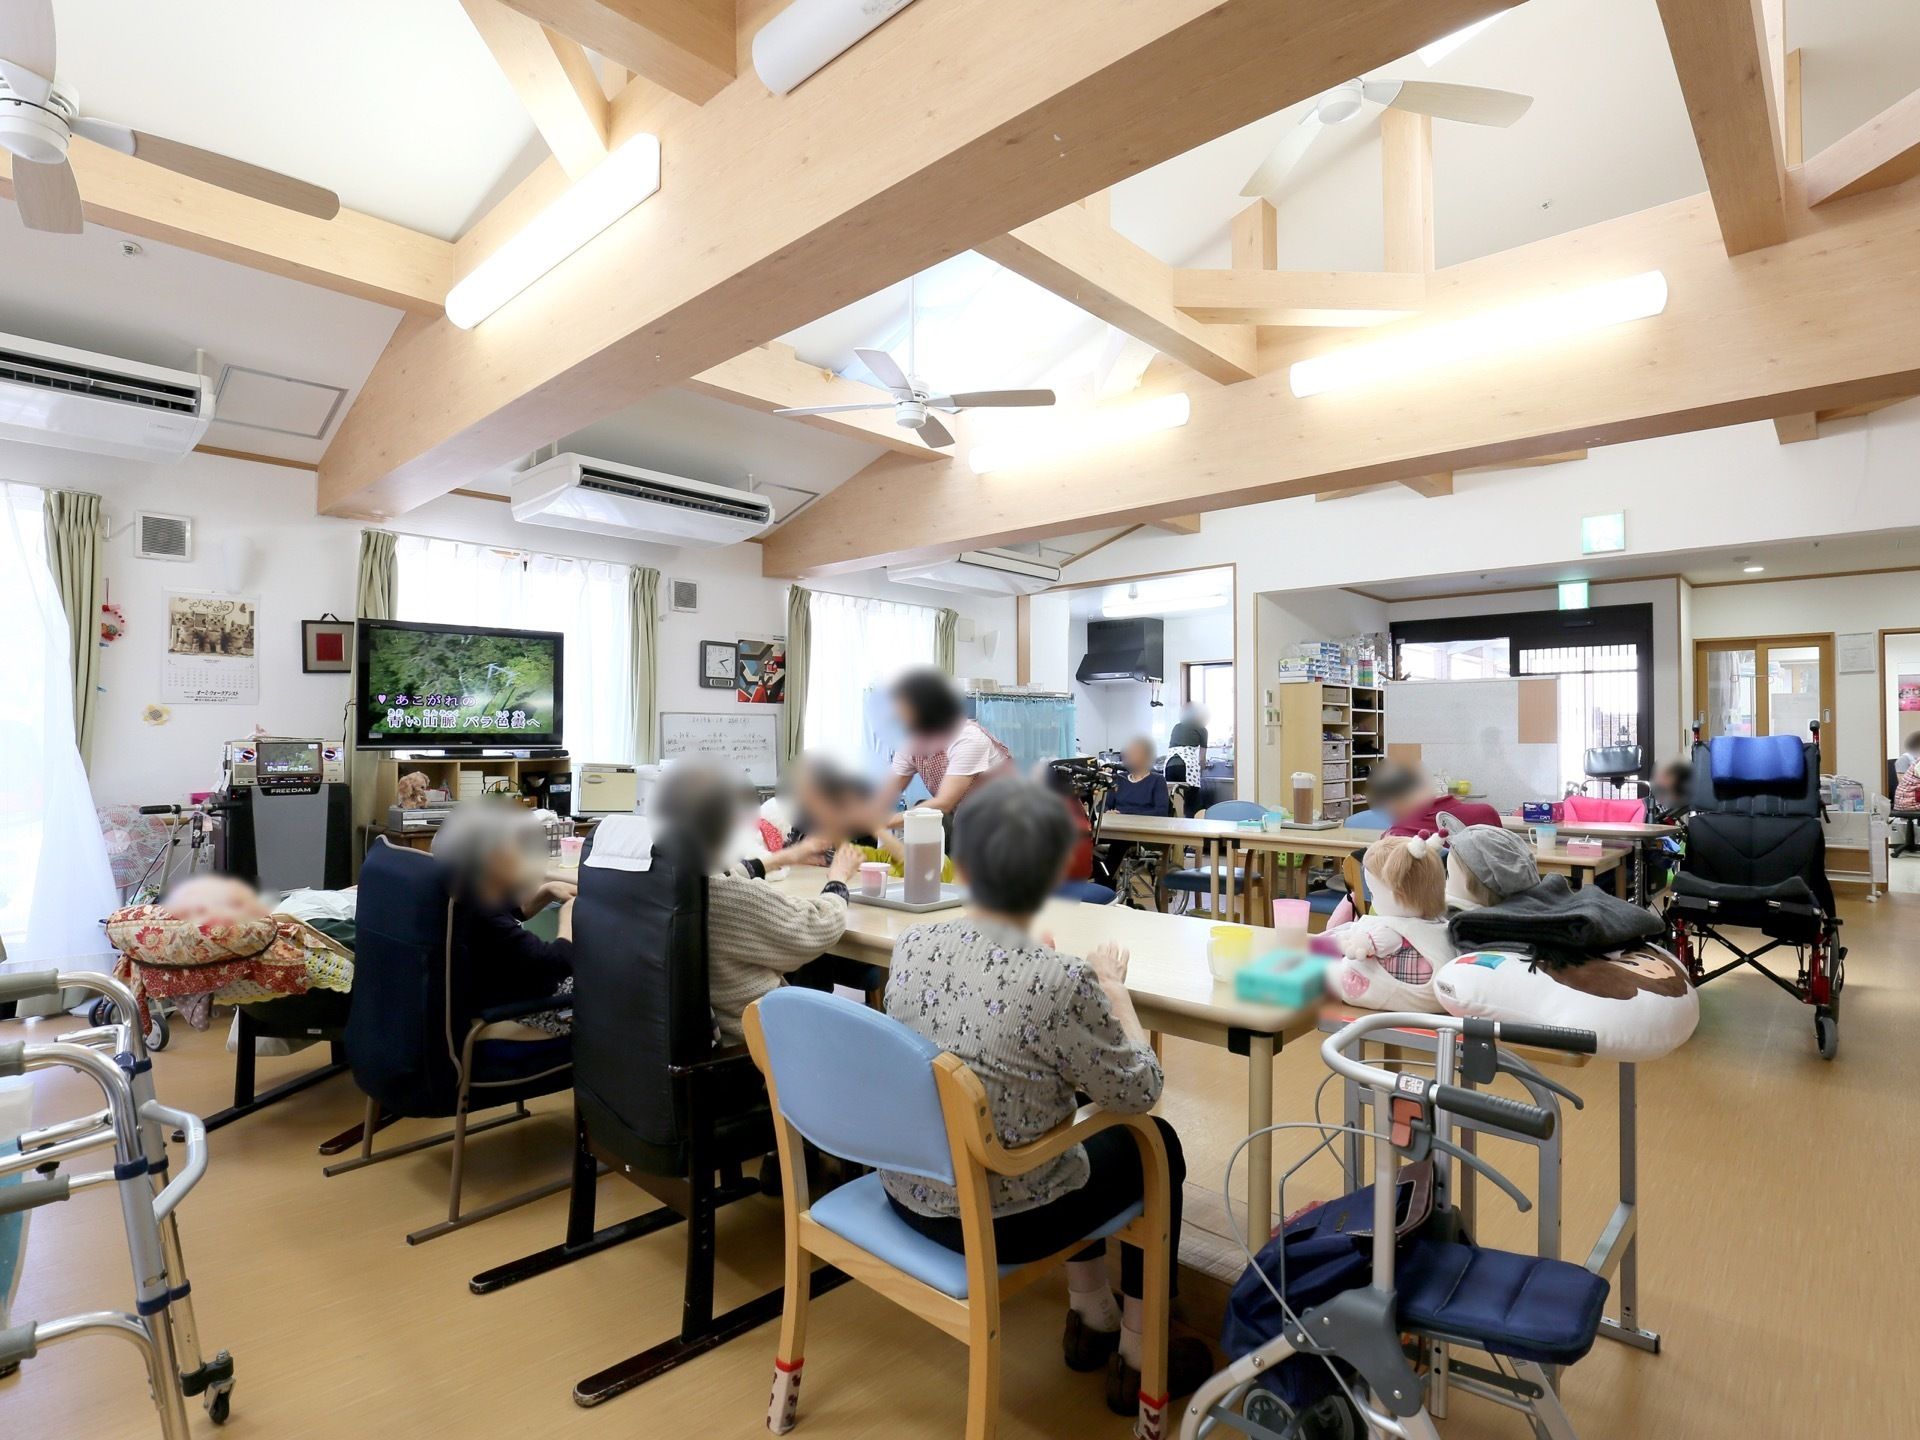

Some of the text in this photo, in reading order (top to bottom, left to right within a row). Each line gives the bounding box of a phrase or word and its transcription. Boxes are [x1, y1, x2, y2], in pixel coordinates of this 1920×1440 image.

[395, 694, 477, 707] あこがれの
[387, 714, 457, 729] 青い山脈
